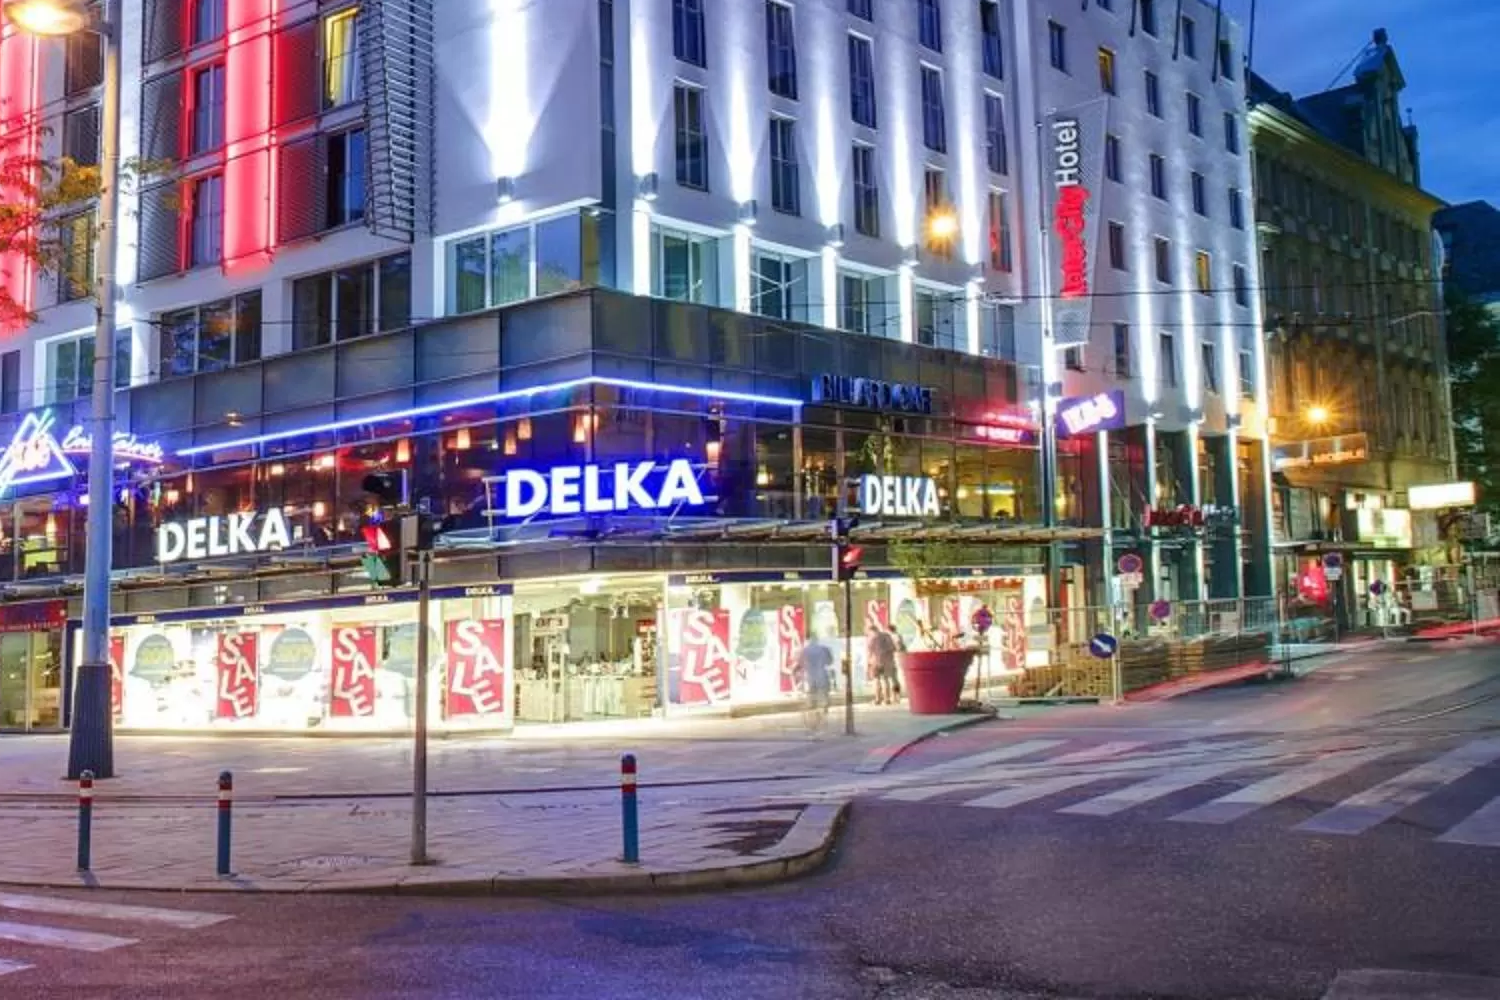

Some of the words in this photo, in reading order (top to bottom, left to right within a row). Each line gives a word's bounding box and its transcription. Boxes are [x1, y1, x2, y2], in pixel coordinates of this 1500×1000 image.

[506, 458, 704, 517] DELKA
[862, 474, 940, 516] DELKA
[159, 507, 290, 562] DELKA
[219, 632, 256, 717] SALE
[334, 628, 374, 716] SALE
[451, 619, 503, 713] SALE
[683, 610, 736, 703] SALE
